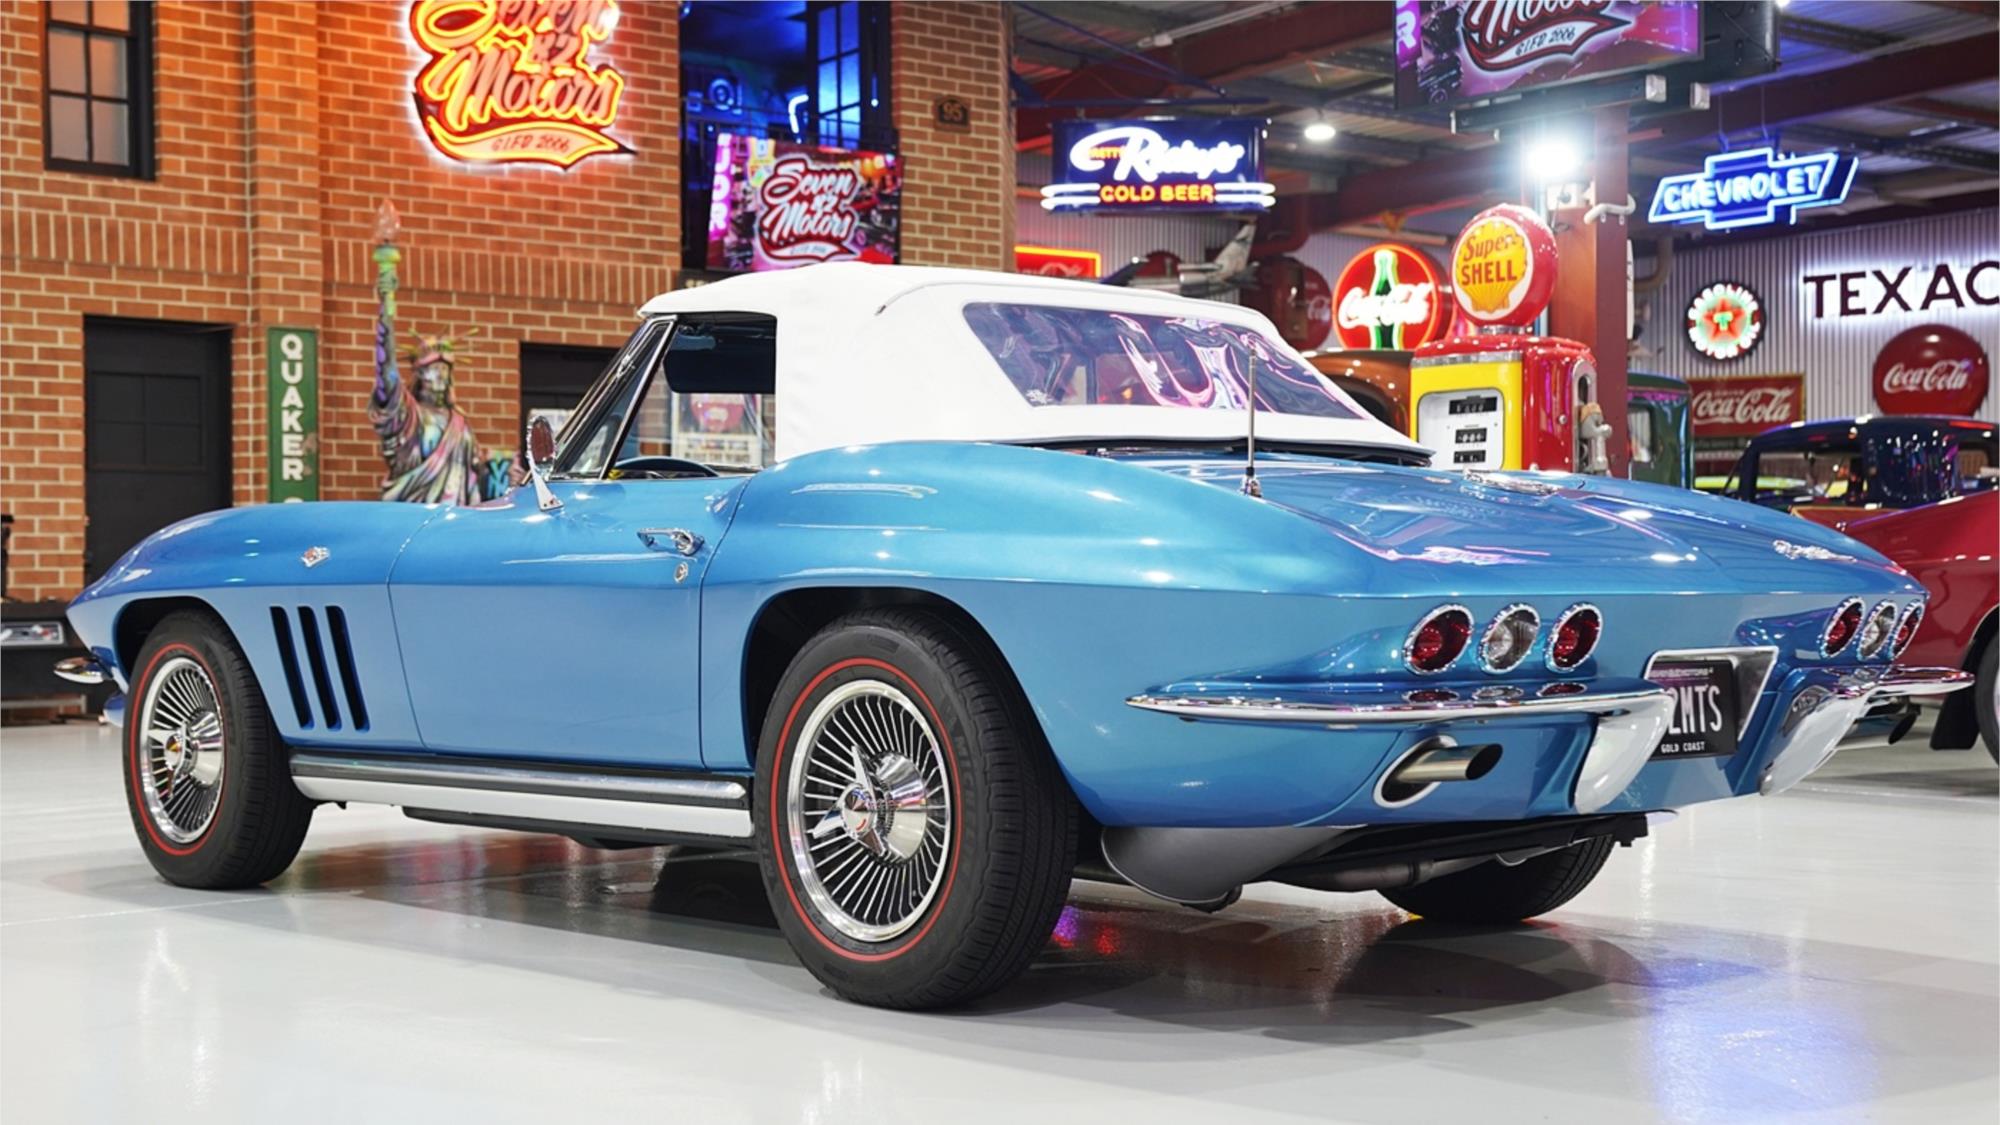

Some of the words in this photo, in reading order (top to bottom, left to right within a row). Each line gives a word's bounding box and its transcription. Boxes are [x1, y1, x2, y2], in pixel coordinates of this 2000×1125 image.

[424, 47, 624, 131] Motors
[767, 160, 853, 207] Seven
[1099, 184, 1155, 203] COLD
[1159, 184, 1215, 203] BEER
[1663, 164, 1823, 212] CHEVROLET
[762, 201, 852, 243] Motors
[1461, 259, 1518, 286] SHELL
[280, 333, 305, 482] QUAKER
[1661, 743, 1680, 754] GOLD
[1683, 740, 1706, 752] COAST
